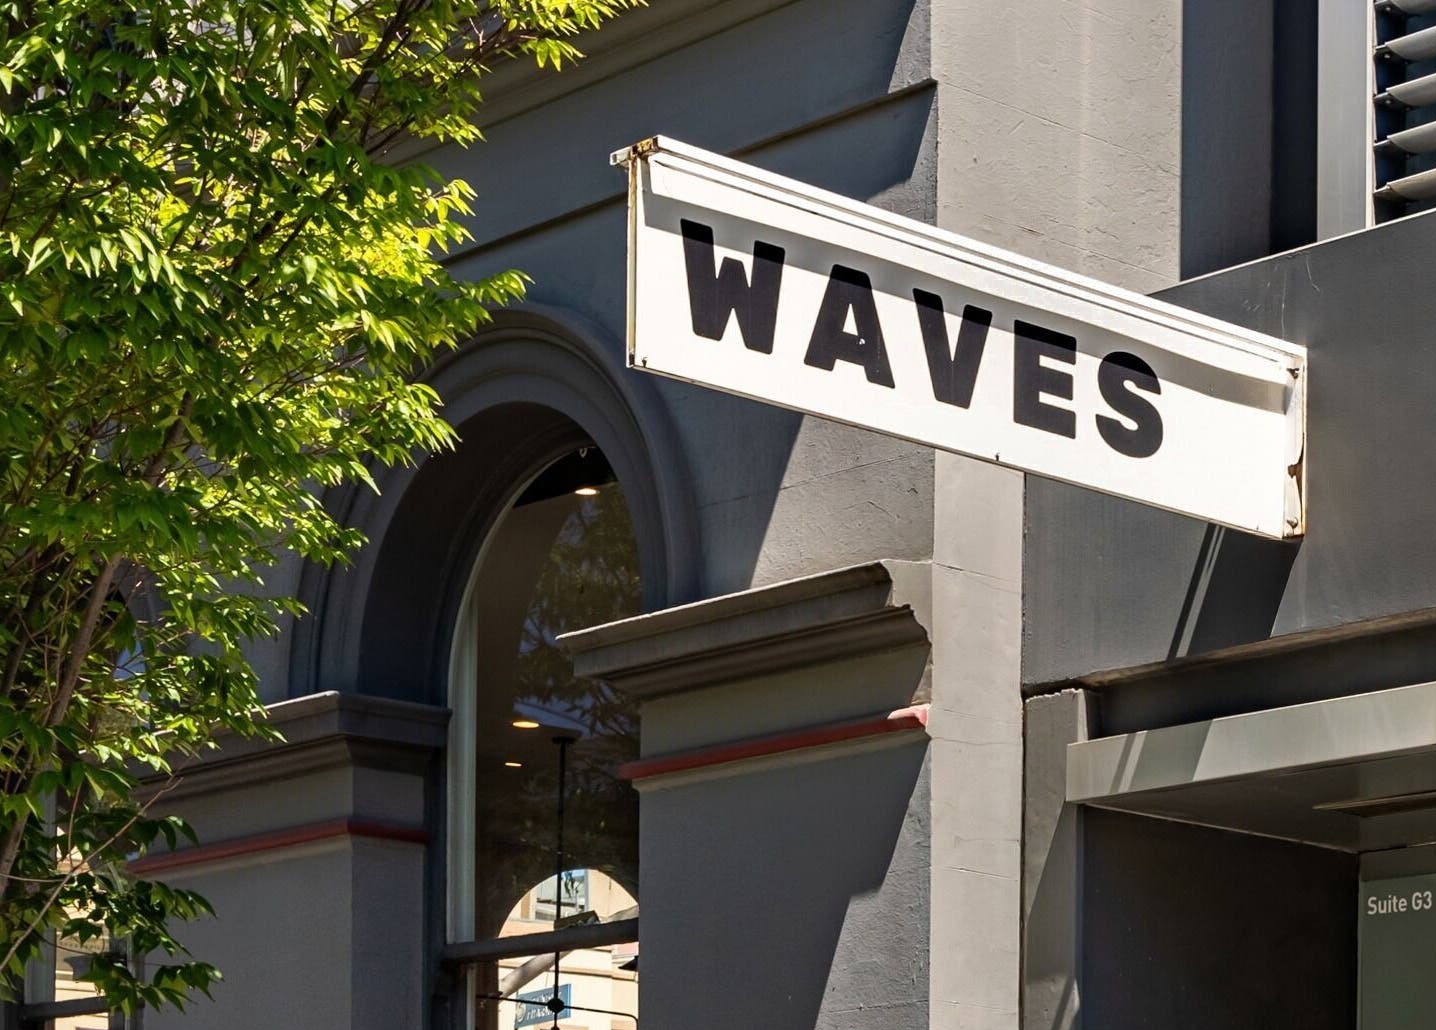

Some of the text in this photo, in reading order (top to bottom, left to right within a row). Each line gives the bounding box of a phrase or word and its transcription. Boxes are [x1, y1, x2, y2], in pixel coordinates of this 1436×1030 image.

[680, 218, 1163, 458] WAVES
[1367, 891, 1432, 915] Suite G3
